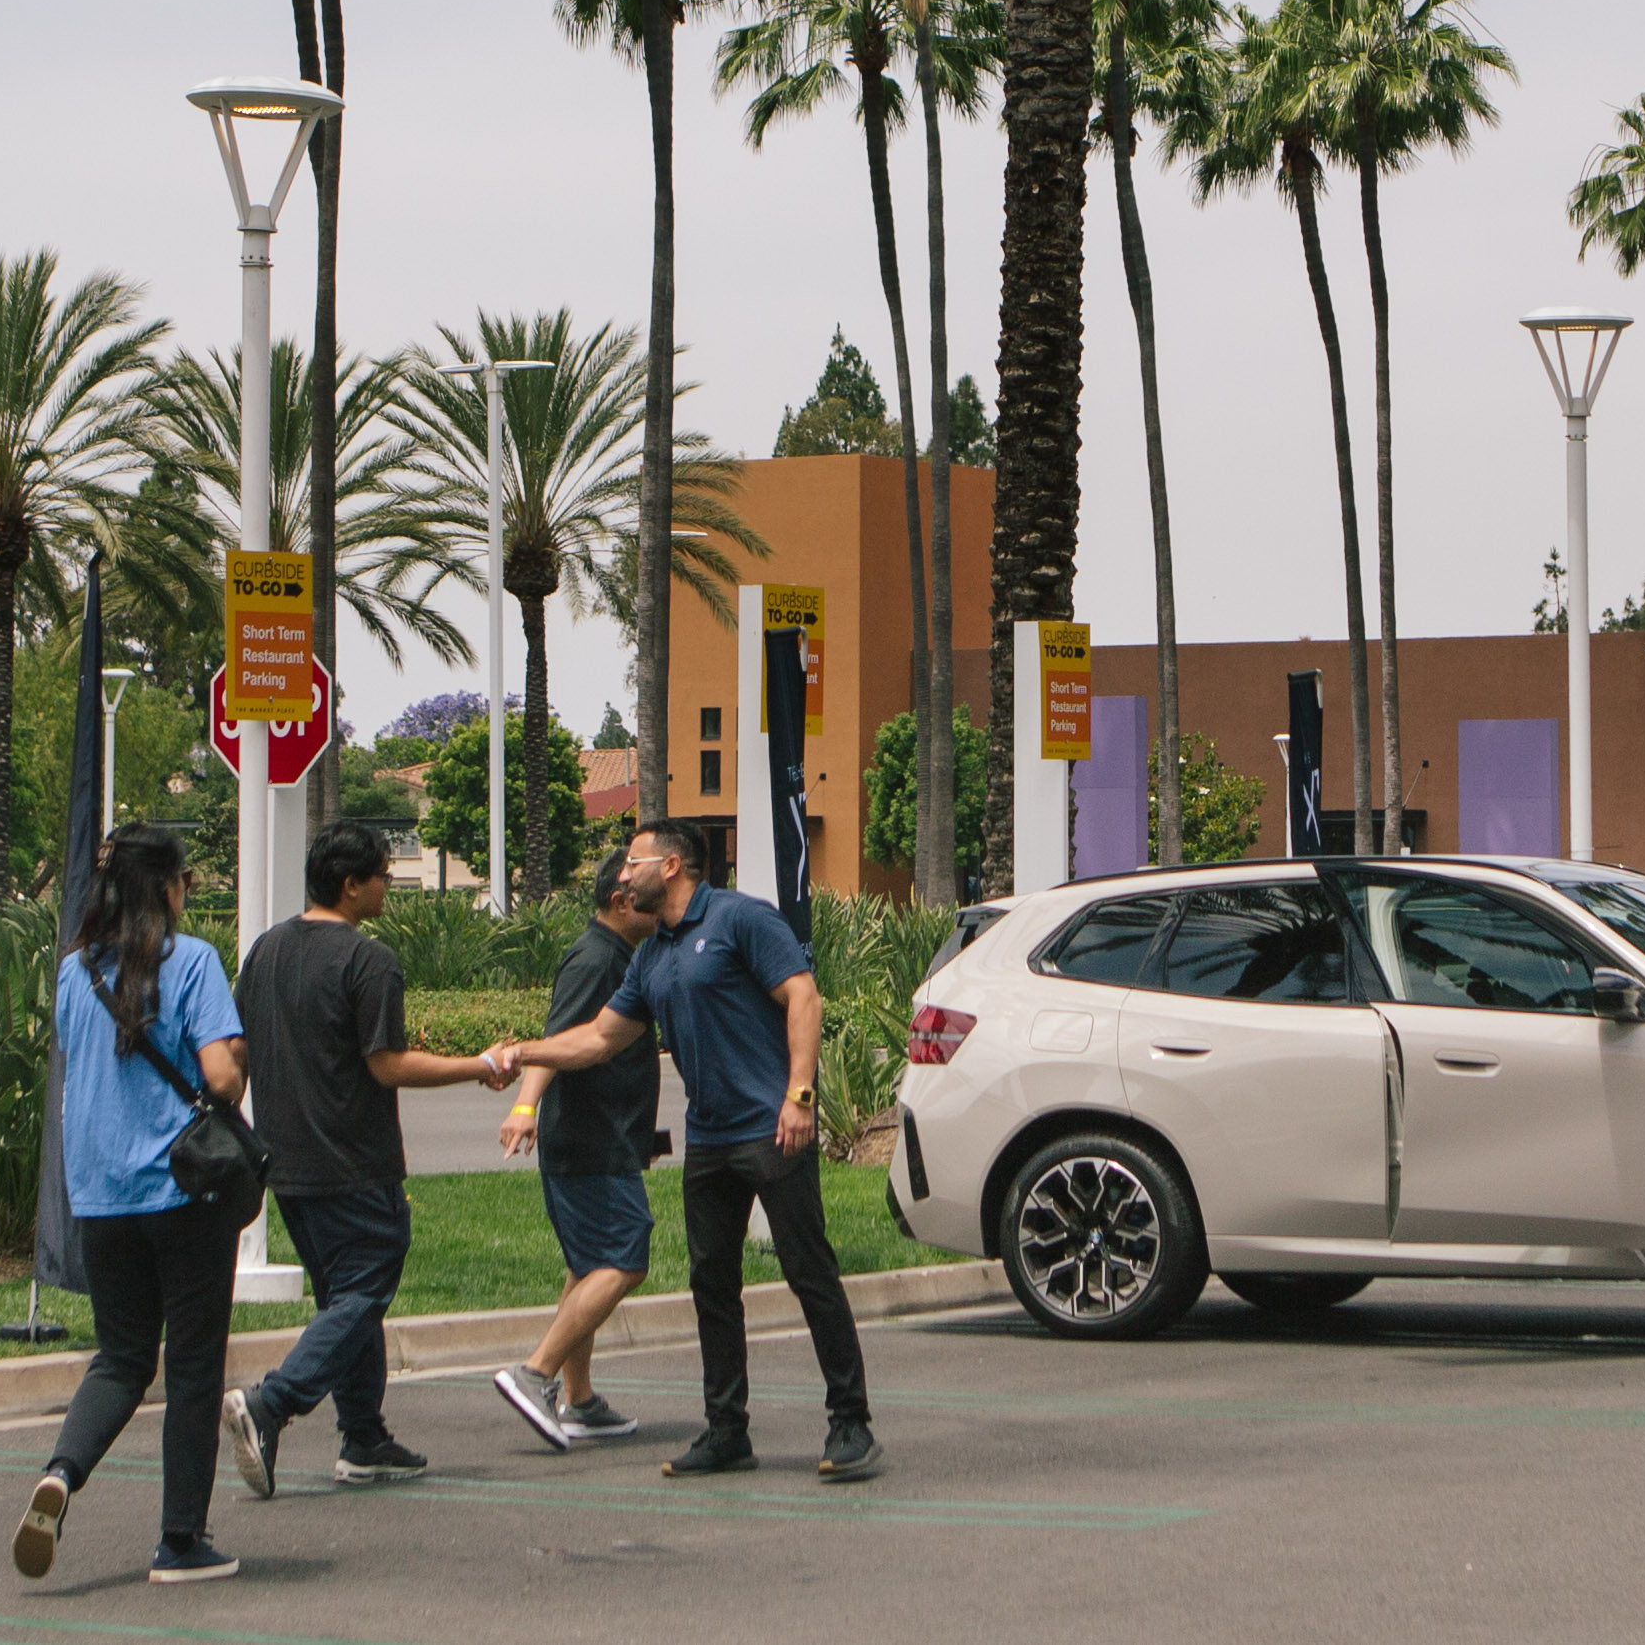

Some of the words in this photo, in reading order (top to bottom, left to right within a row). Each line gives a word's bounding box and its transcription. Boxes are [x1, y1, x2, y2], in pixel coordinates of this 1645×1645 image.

[233, 561, 305, 580] CURBSIDE
[233, 579, 282, 596] TO-GO
[767, 592, 819, 610] CURBSIDE
[766, 608, 803, 624] TO-GO
[242, 624, 274, 641] Short
[277, 626, 305, 642] Term
[1043, 629, 1087, 645] CURBSIDE
[242, 647, 305, 665] Restaurant
[1044, 644, 1074, 658] TO-GO
[242, 670, 286, 690] Parking
[1050, 681, 1070, 694] Short
[1071, 681, 1087, 694] Term
[1050, 700, 1087, 714] Restaurant
[1050, 719, 1077, 735] Parking
